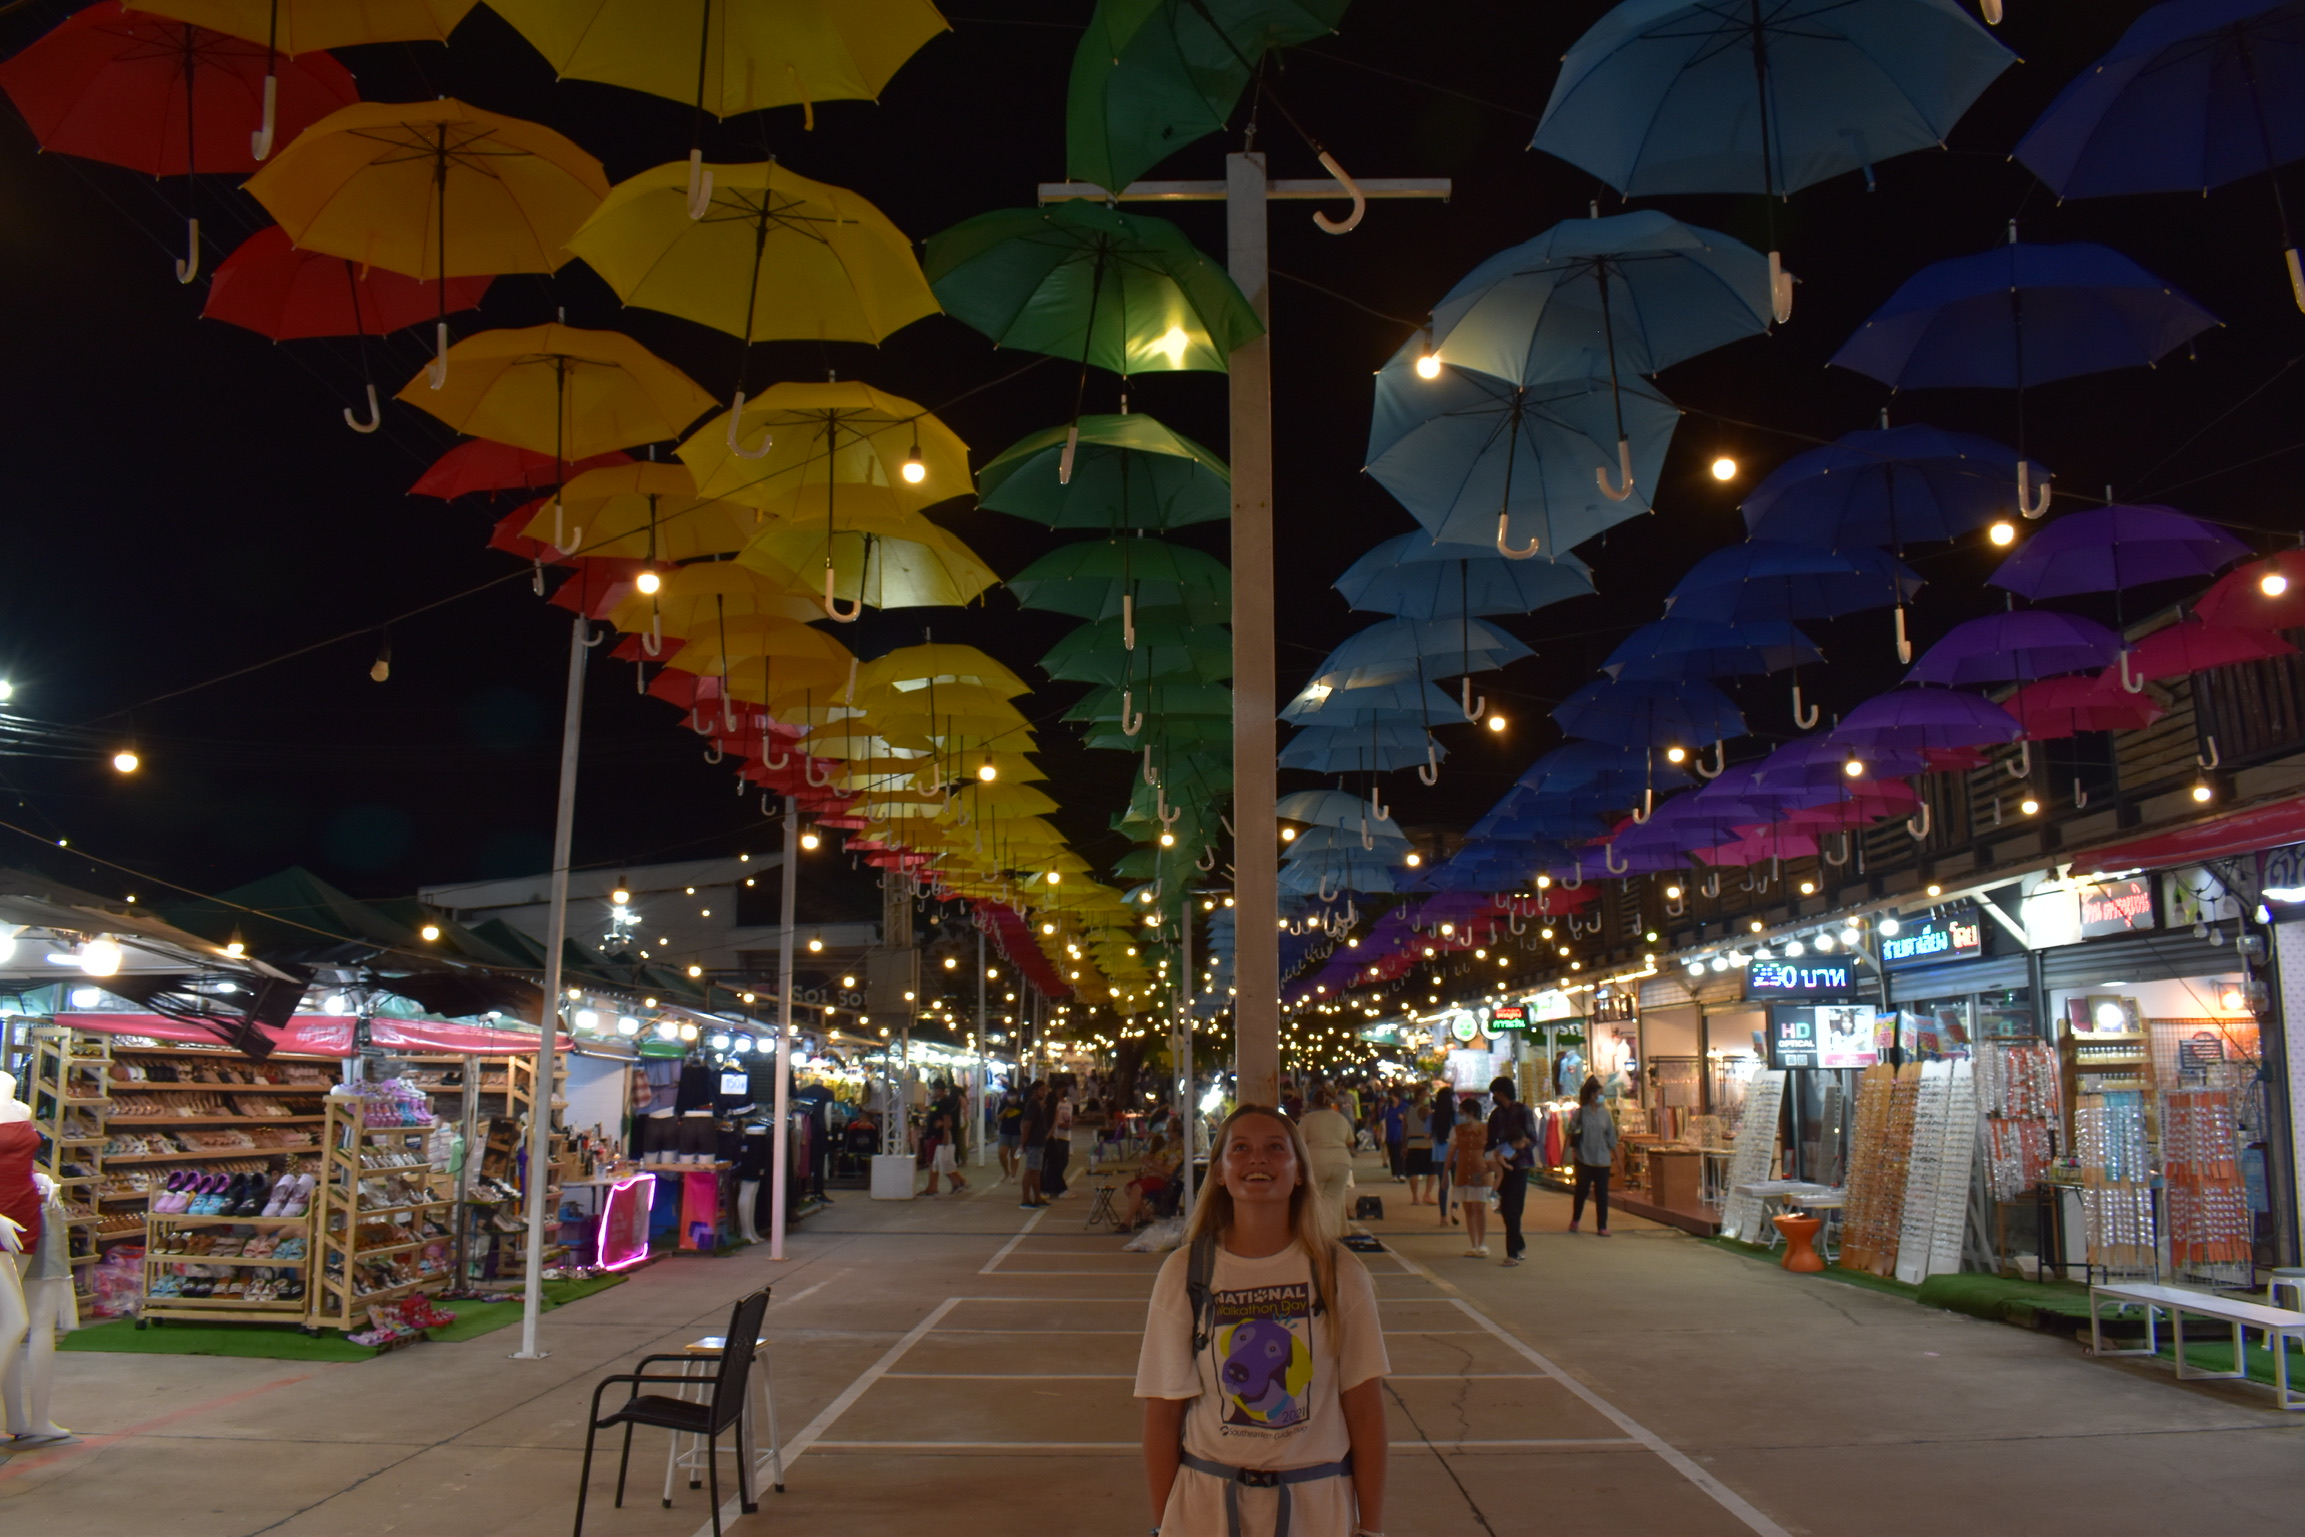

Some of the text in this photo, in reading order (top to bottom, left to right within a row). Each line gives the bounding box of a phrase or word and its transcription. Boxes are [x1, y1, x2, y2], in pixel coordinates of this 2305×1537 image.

[1801, 968, 1846, 988] บาท
[1781, 1023, 1810, 1038] HD
[1778, 1039, 1815, 1048] OPTICAL
[1281, 1300, 1307, 1317] Day
[1282, 1406, 1305, 1423] 2021
